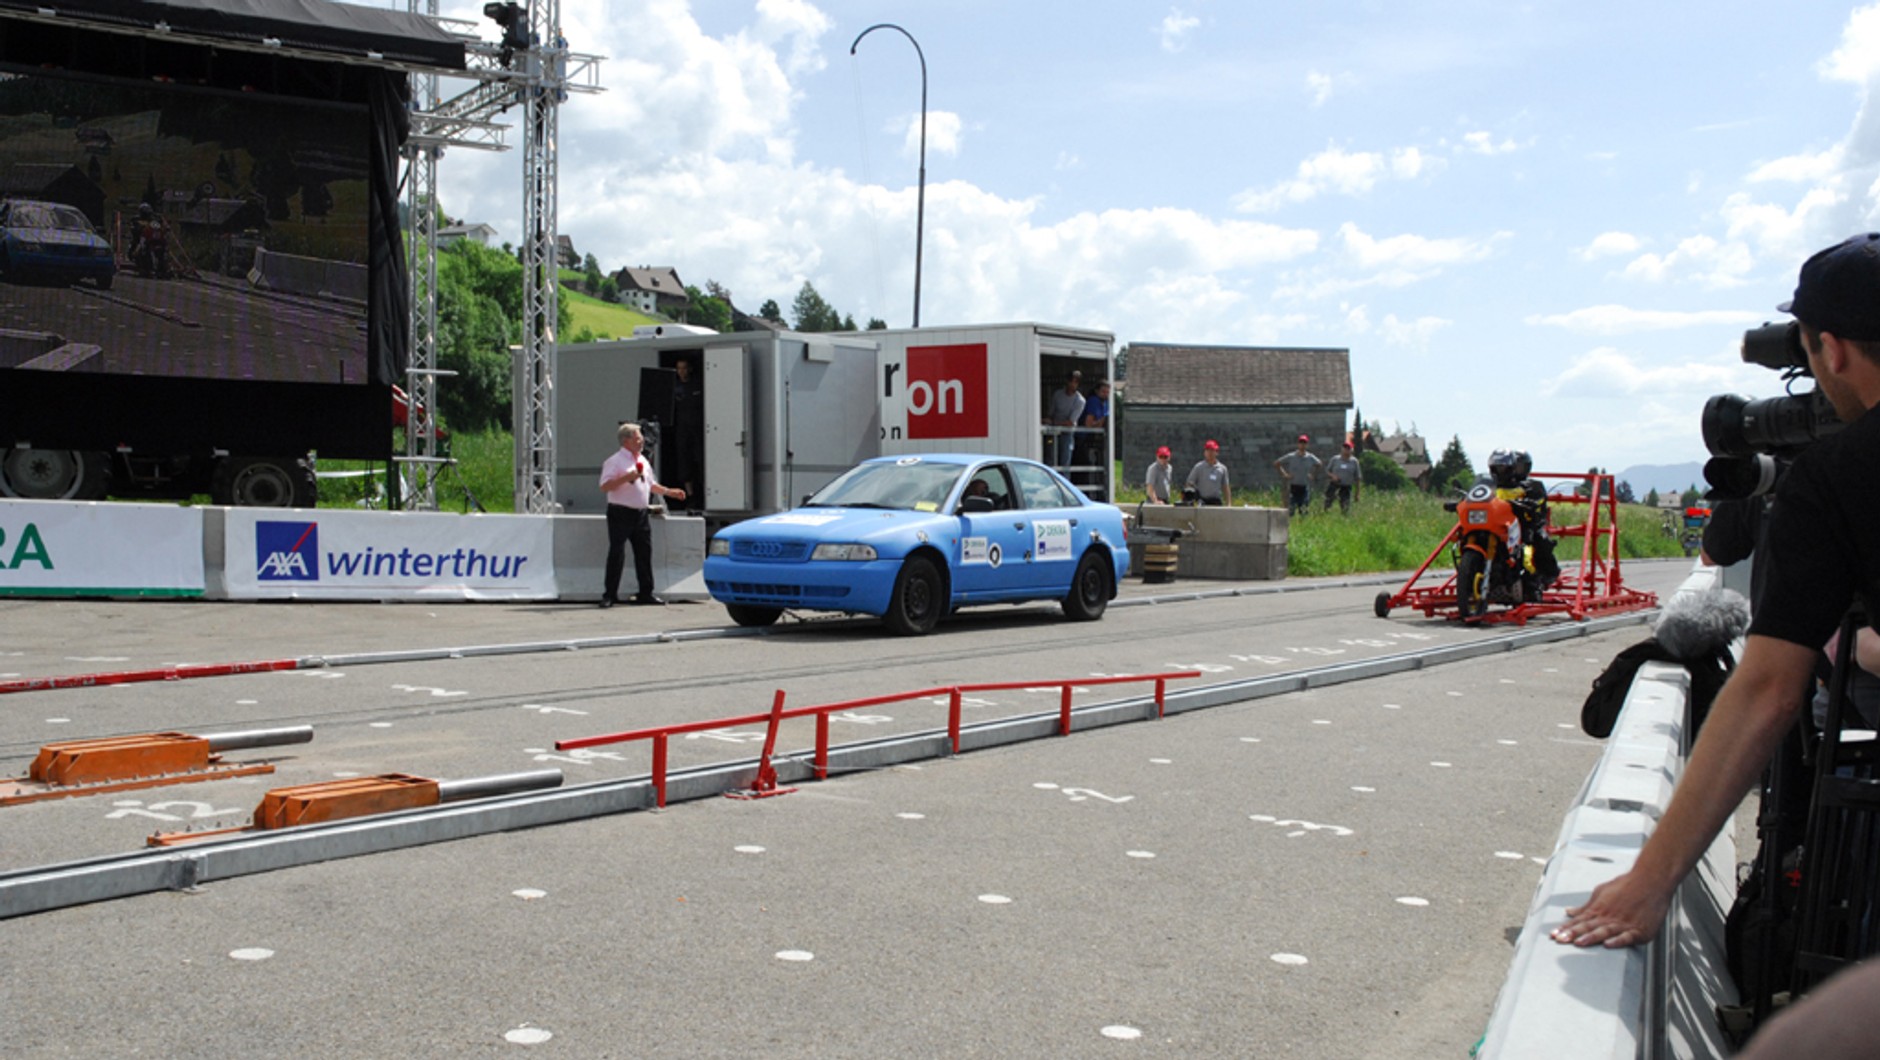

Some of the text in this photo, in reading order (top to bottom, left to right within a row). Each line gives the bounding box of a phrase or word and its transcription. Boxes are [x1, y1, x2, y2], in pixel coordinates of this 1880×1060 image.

[907, 378, 964, 416] on
[0, 522, 55, 570] A
[257, 546, 528, 578] AXA winterthur
